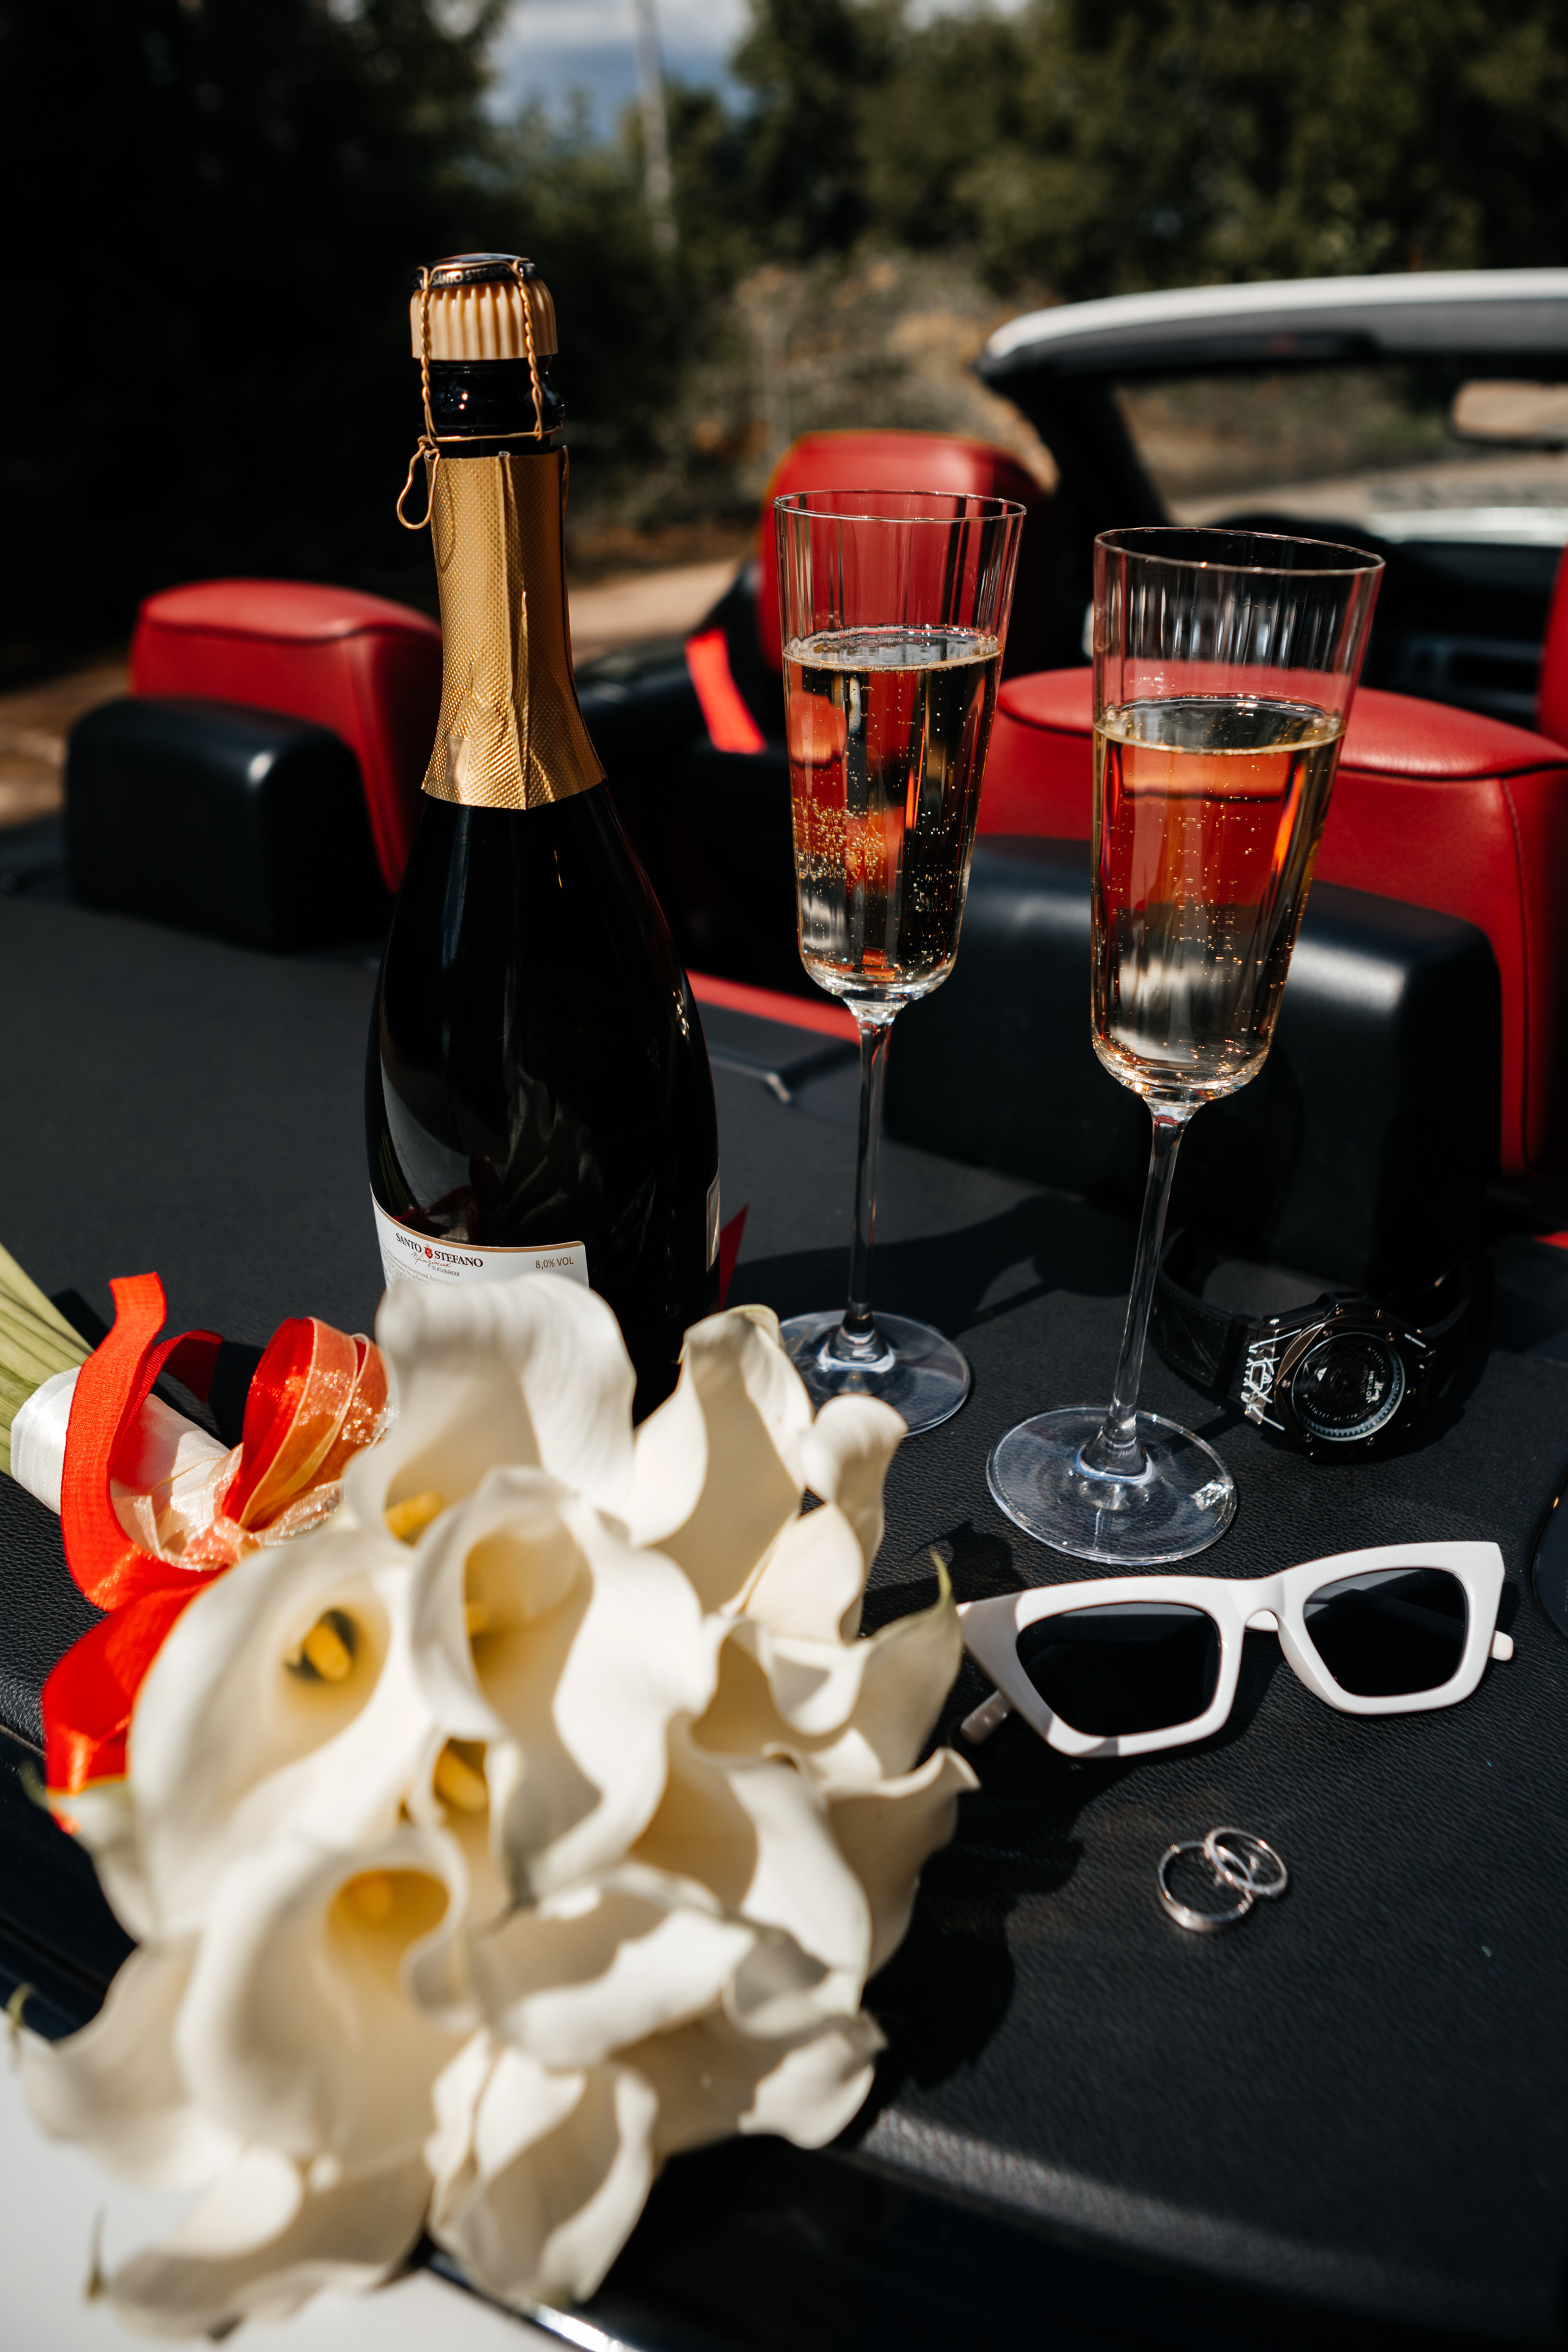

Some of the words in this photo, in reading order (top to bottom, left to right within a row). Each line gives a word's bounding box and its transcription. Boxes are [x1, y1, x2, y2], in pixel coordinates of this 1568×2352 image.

[432, 270, 464, 285] SANTO
[466, 266, 510, 281] STEFANO
[396, 1232, 422, 1253] SANTO
[434, 1250, 483, 1267] STEFANO
[535, 1259, 555, 1270] 8,0%
[556, 1256, 574, 1266] VOL
